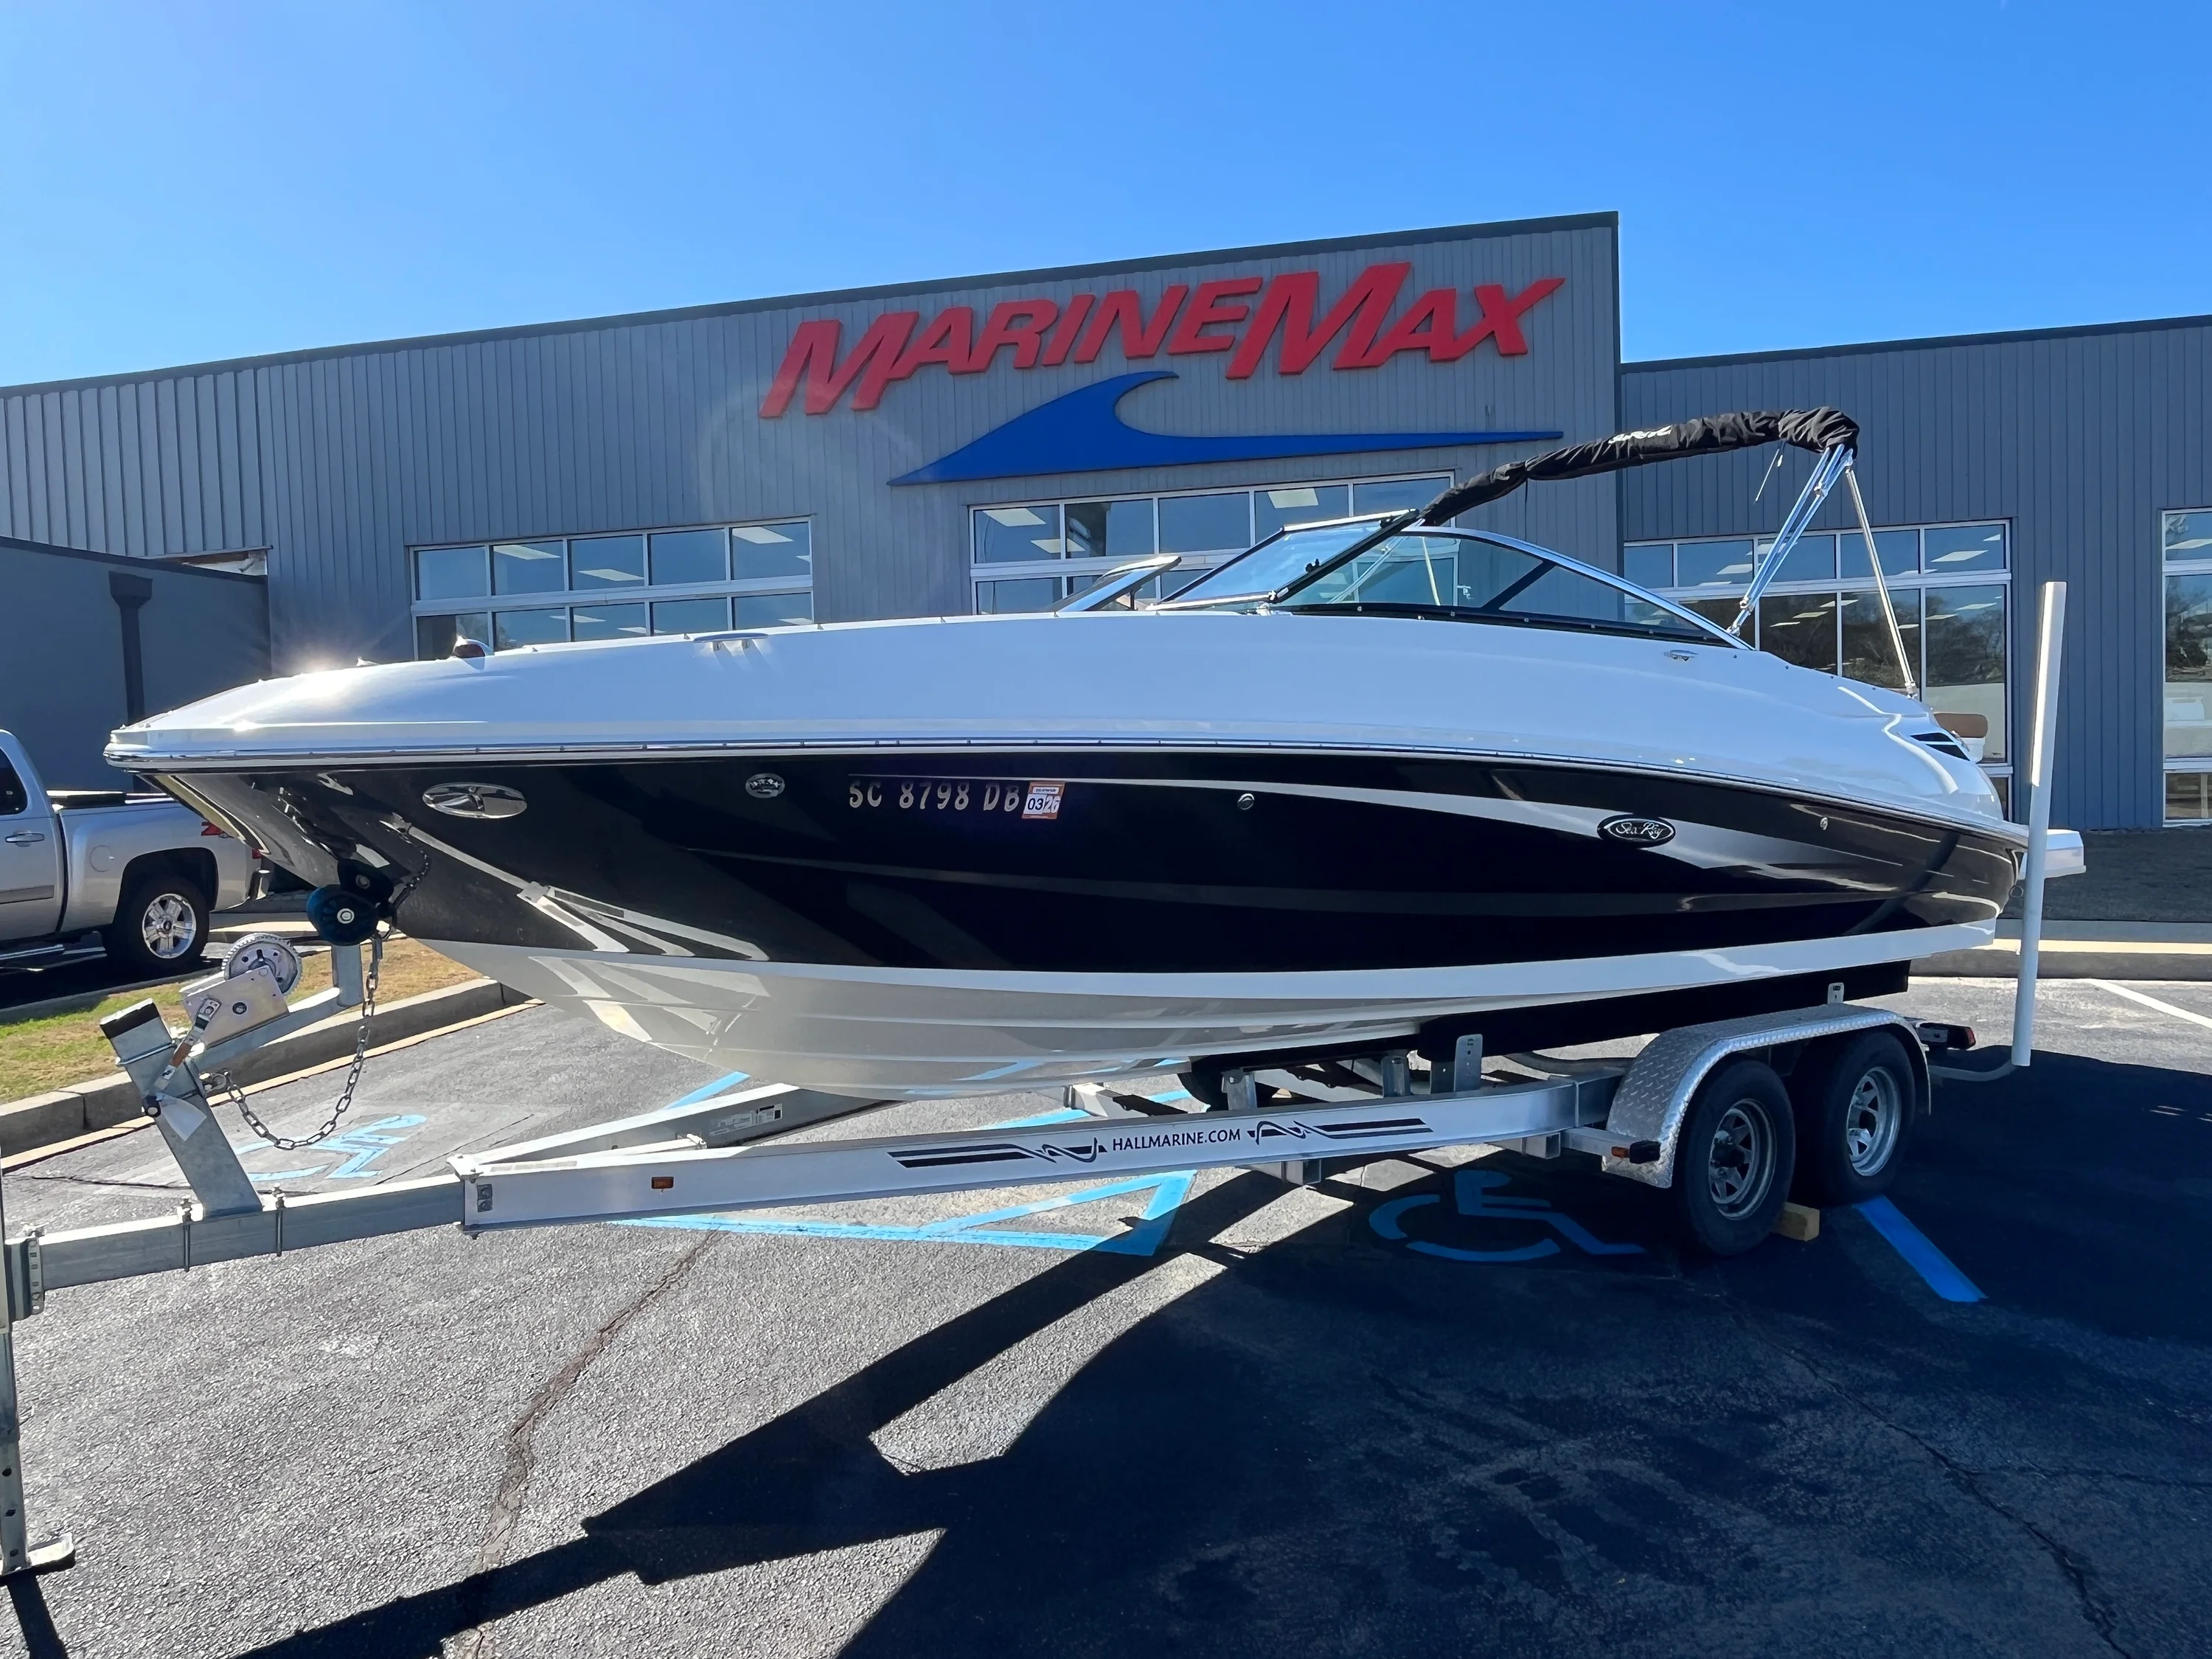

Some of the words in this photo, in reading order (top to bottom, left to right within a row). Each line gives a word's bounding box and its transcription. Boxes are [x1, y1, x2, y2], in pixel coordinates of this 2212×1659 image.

[849, 780, 882, 808] SC
[899, 781, 970, 810] 8798
[984, 781, 1020, 812] DB
[1113, 1128, 1241, 1151] HALLMARINE.COM
